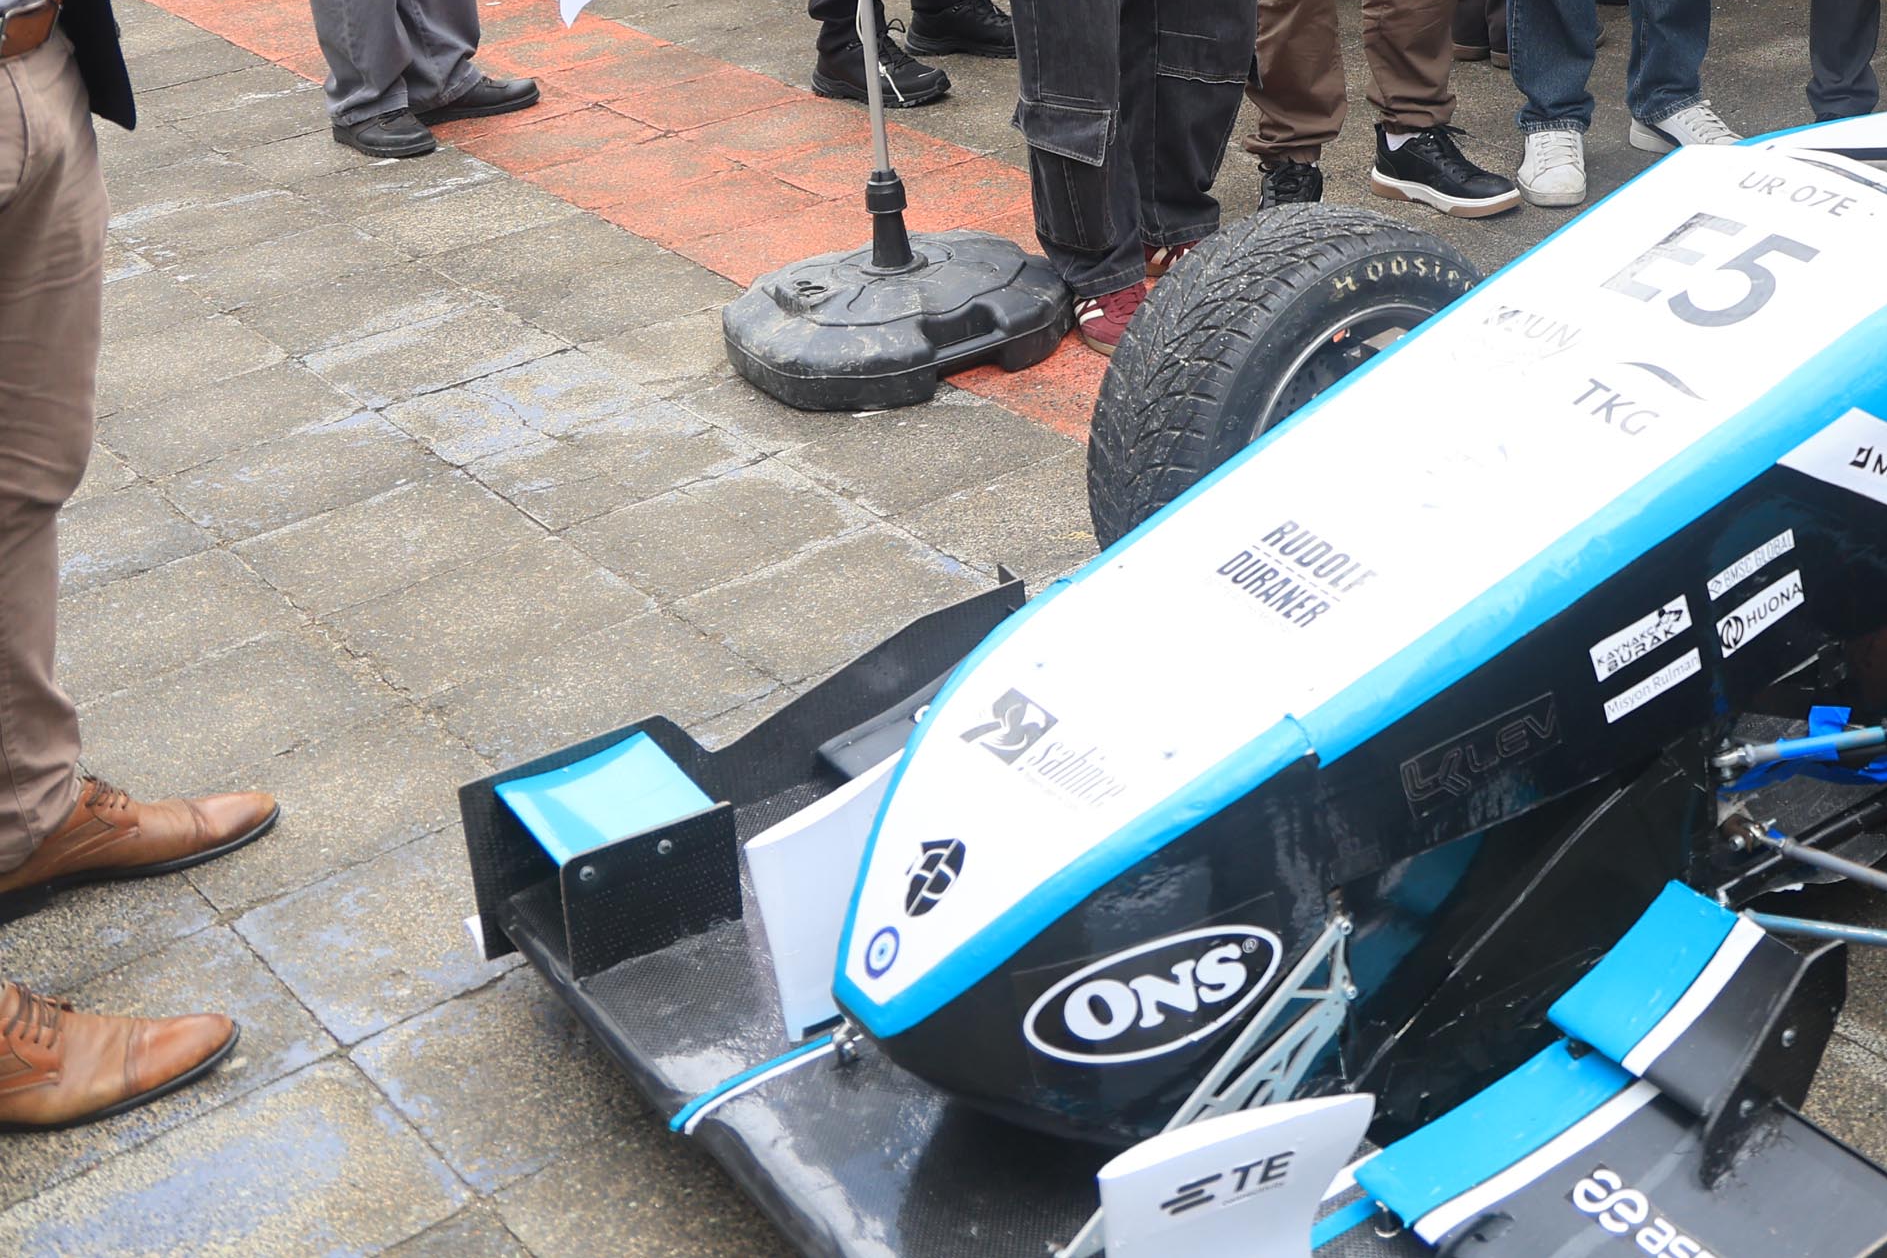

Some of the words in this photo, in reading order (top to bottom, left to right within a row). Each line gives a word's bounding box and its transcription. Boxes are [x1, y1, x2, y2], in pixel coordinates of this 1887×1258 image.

[1599, 211, 1821, 328] E5
[1572, 377, 1660, 437] TKG
[1754, 534, 1794, 568] GLOBAL
[1216, 550, 1331, 628] DURANER
[1607, 623, 1677, 673] BURAK
[1604, 685, 1651, 716] Misyon
[1063, 943, 1248, 1041] ONS
[1231, 1149, 1296, 1193] TE
